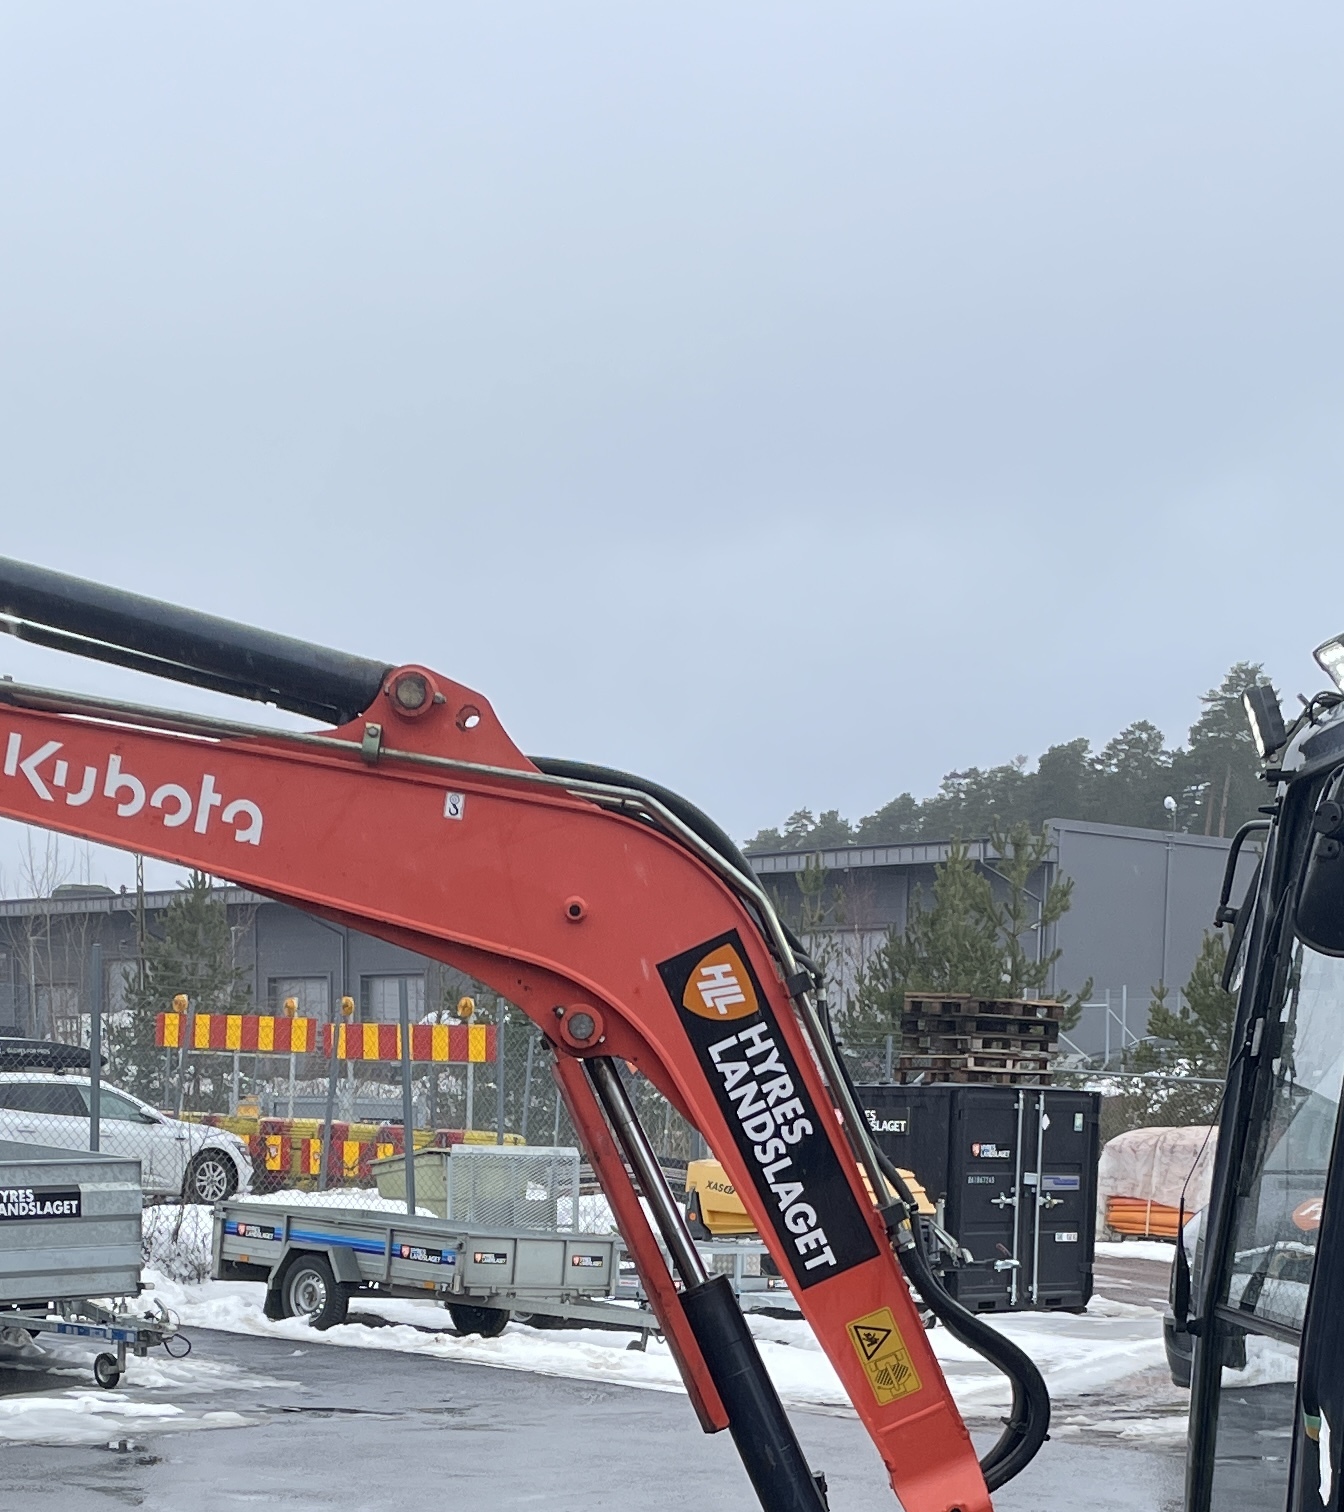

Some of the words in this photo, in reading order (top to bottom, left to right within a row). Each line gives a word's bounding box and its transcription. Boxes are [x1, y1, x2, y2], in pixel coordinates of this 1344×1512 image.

[4, 732, 263, 846] Kubota
[737, 1021, 813, 1145] HYRES
[871, 1120, 907, 1132] SLAGET
[708, 1035, 837, 1271] LANDSLAGET
